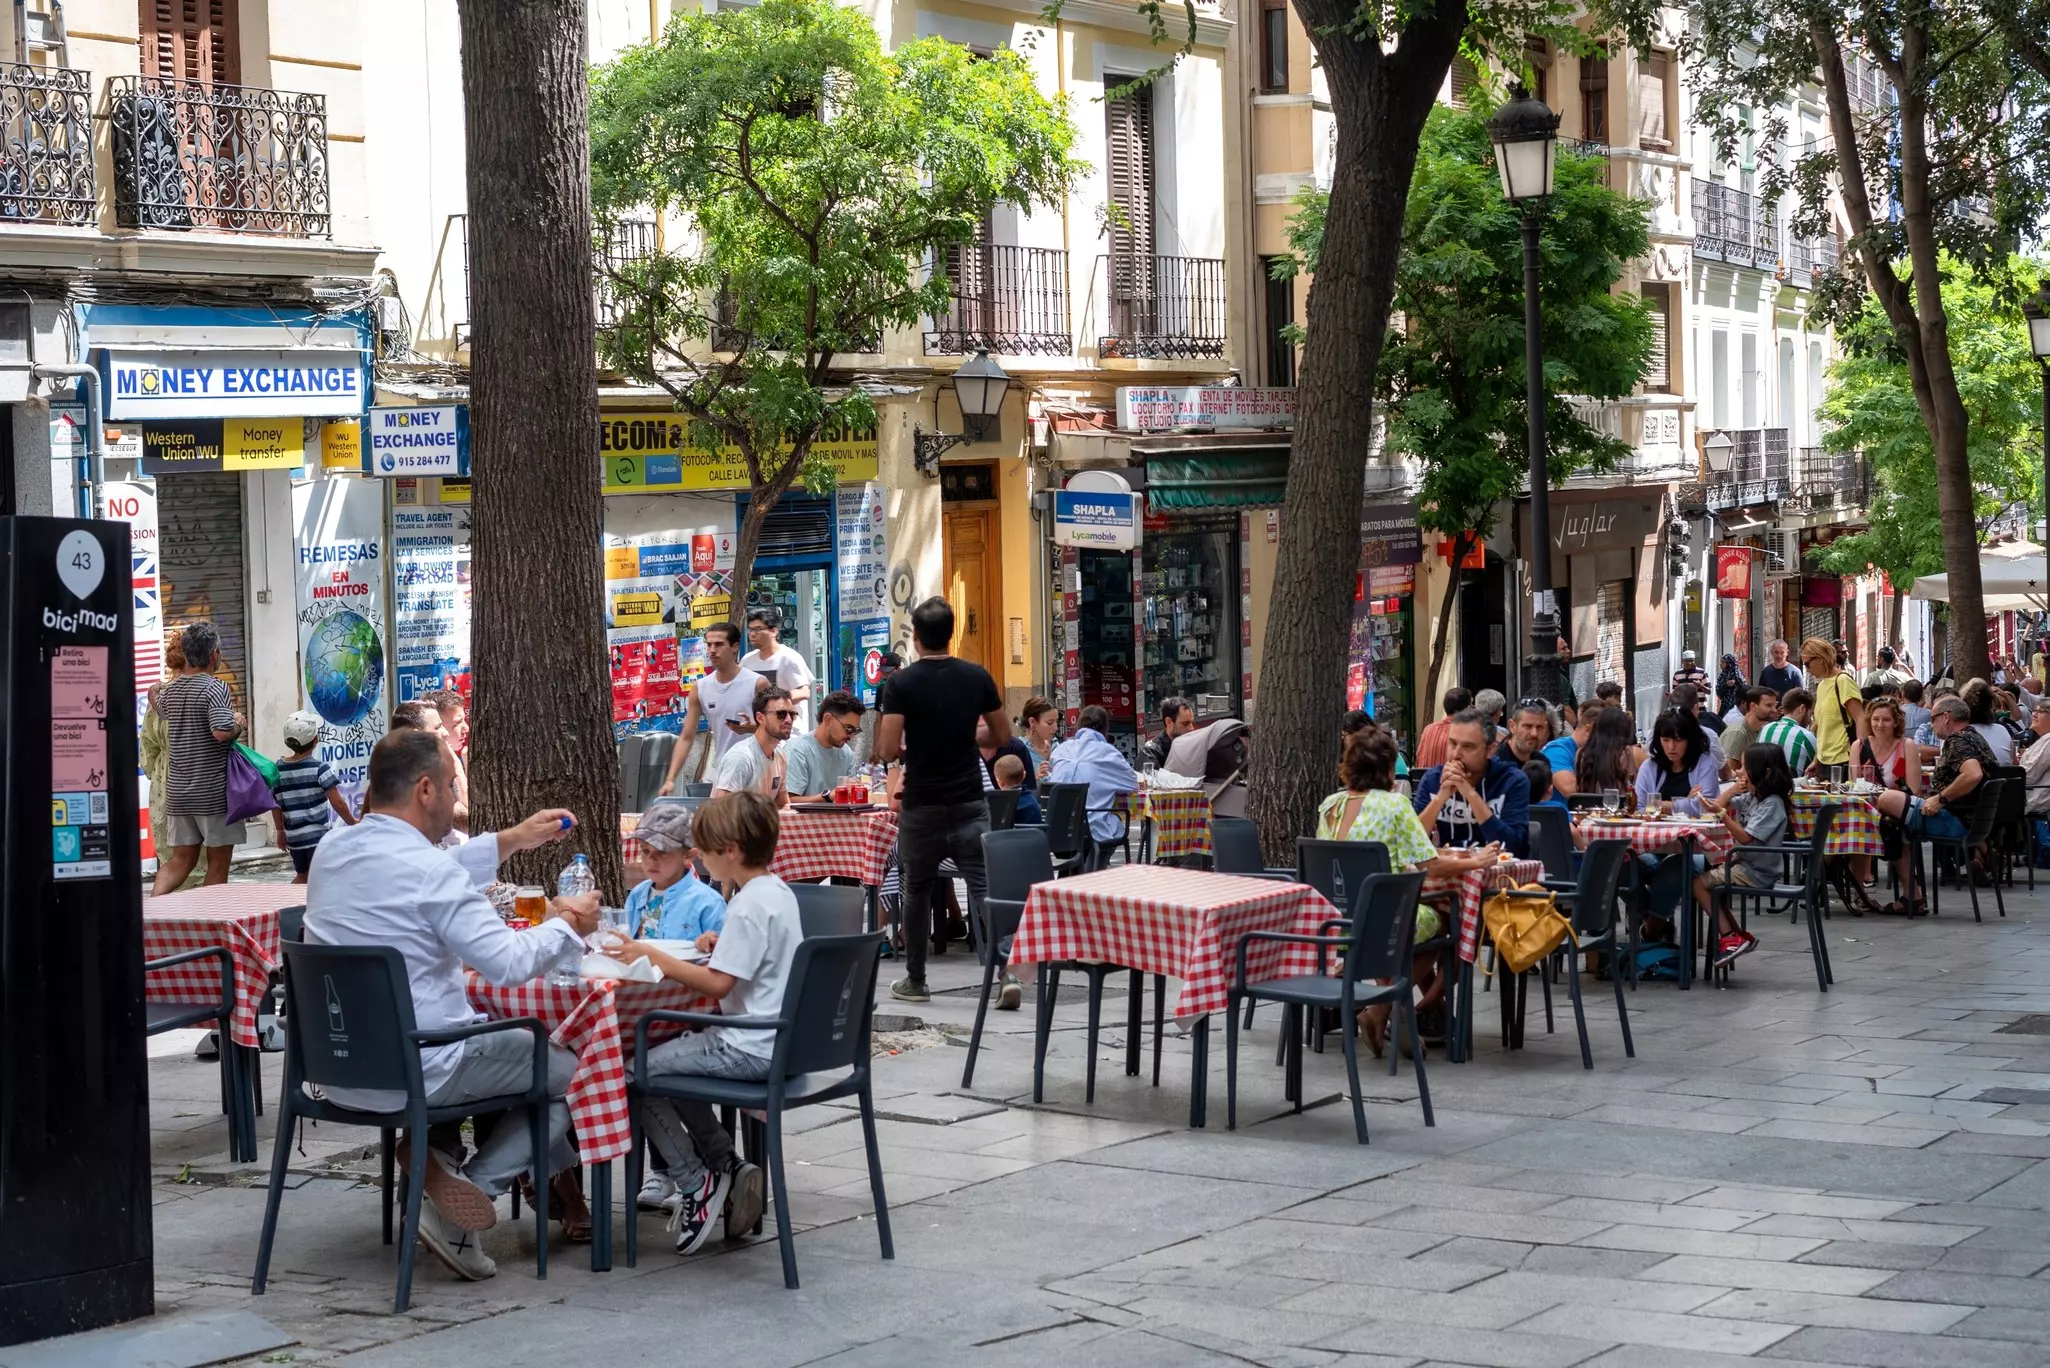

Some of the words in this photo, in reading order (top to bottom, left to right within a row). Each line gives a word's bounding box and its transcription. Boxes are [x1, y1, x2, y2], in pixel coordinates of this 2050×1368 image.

[223, 367, 357, 393] EXCHANGE
[1128, 390, 1169, 402] SHAPLA
[1198, 390, 1220, 401] VENTA
[1223, 390, 1232, 401] DE
[1235, 390, 1264, 402] MOVILES
[1132, 402, 1175, 414] LOCUTORIO
[1178, 402, 1194, 414] FAX
[1198, 403, 1233, 414] INTERNET
[1236, 403, 1280, 414] FOTOCOPIAS
[1138, 415, 1172, 427] ESTUDIO
[145, 431, 195, 446] Western
[243, 427, 283, 444] Money
[335, 432, 350, 441] WU
[373, 432, 456, 449] EXCHANGE
[669, 423, 682, 449] &
[239, 444, 286, 460] transfer
[328, 442, 358, 451] Western
[161, 445, 196, 461] Union
[333, 451, 354, 460] Union
[831, 448, 854, 460] MÓVIL
[855, 449, 860, 459] Y
[861, 448, 877, 459] MAS
[398, 456, 415, 466] 915
[416, 455, 433, 466] 284
[434, 455, 451, 466] 477
[709, 468, 732, 481] CALLE
[109, 497, 140, 518] NO
[1073, 504, 1116, 517] SHAPLA
[395, 513, 425, 523] TRAVEL
[426, 512, 453, 522] AGENT
[839, 523, 871, 534] PRINTING
[1381, 519, 1395, 530] PARA
[396, 535, 454, 547] IMMIGRATION
[1072, 529, 1117, 541] Lycamobile
[839, 539, 858, 547] MEDIA
[858, 538, 871, 546] AND
[300, 542, 379, 564] REMESAS
[396, 548, 413, 557] LAW
[415, 546, 453, 557] SERVICES
[647, 555, 664, 563] BRAC
[664, 552, 687, 562] SAAJAN
[695, 549, 713, 563] Aquí
[839, 549, 850, 557] JOB
[850, 547, 871, 555] CENTRE
[71, 552, 91, 570] 43
[840, 563, 872, 575] WEBSITE
[332, 571, 350, 583] EN
[428, 573, 454, 584] LOAD
[313, 583, 369, 599] MINUTOS
[397, 591, 425, 600] ENGLISH
[426, 590, 454, 598] SPANISH
[841, 588, 856, 596] PHOTO
[398, 599, 454, 612] TRANSLATE
[841, 609, 857, 617] BUYING
[861, 620, 889, 632] Lycamobile
[398, 632, 420, 640] INCLUDE
[62, 649, 84, 657] Retira
[398, 645, 426, 655] SPANISH
[427, 643, 455, 652] ENGLISH
[77, 658, 91, 666] bici
[398, 653, 430, 662] LANGUAGE
[414, 674, 440, 689] Lyca
[53, 722, 87, 731] Devuelve
[69, 732, 82, 740] bici
[321, 740, 374, 762] MONEY
